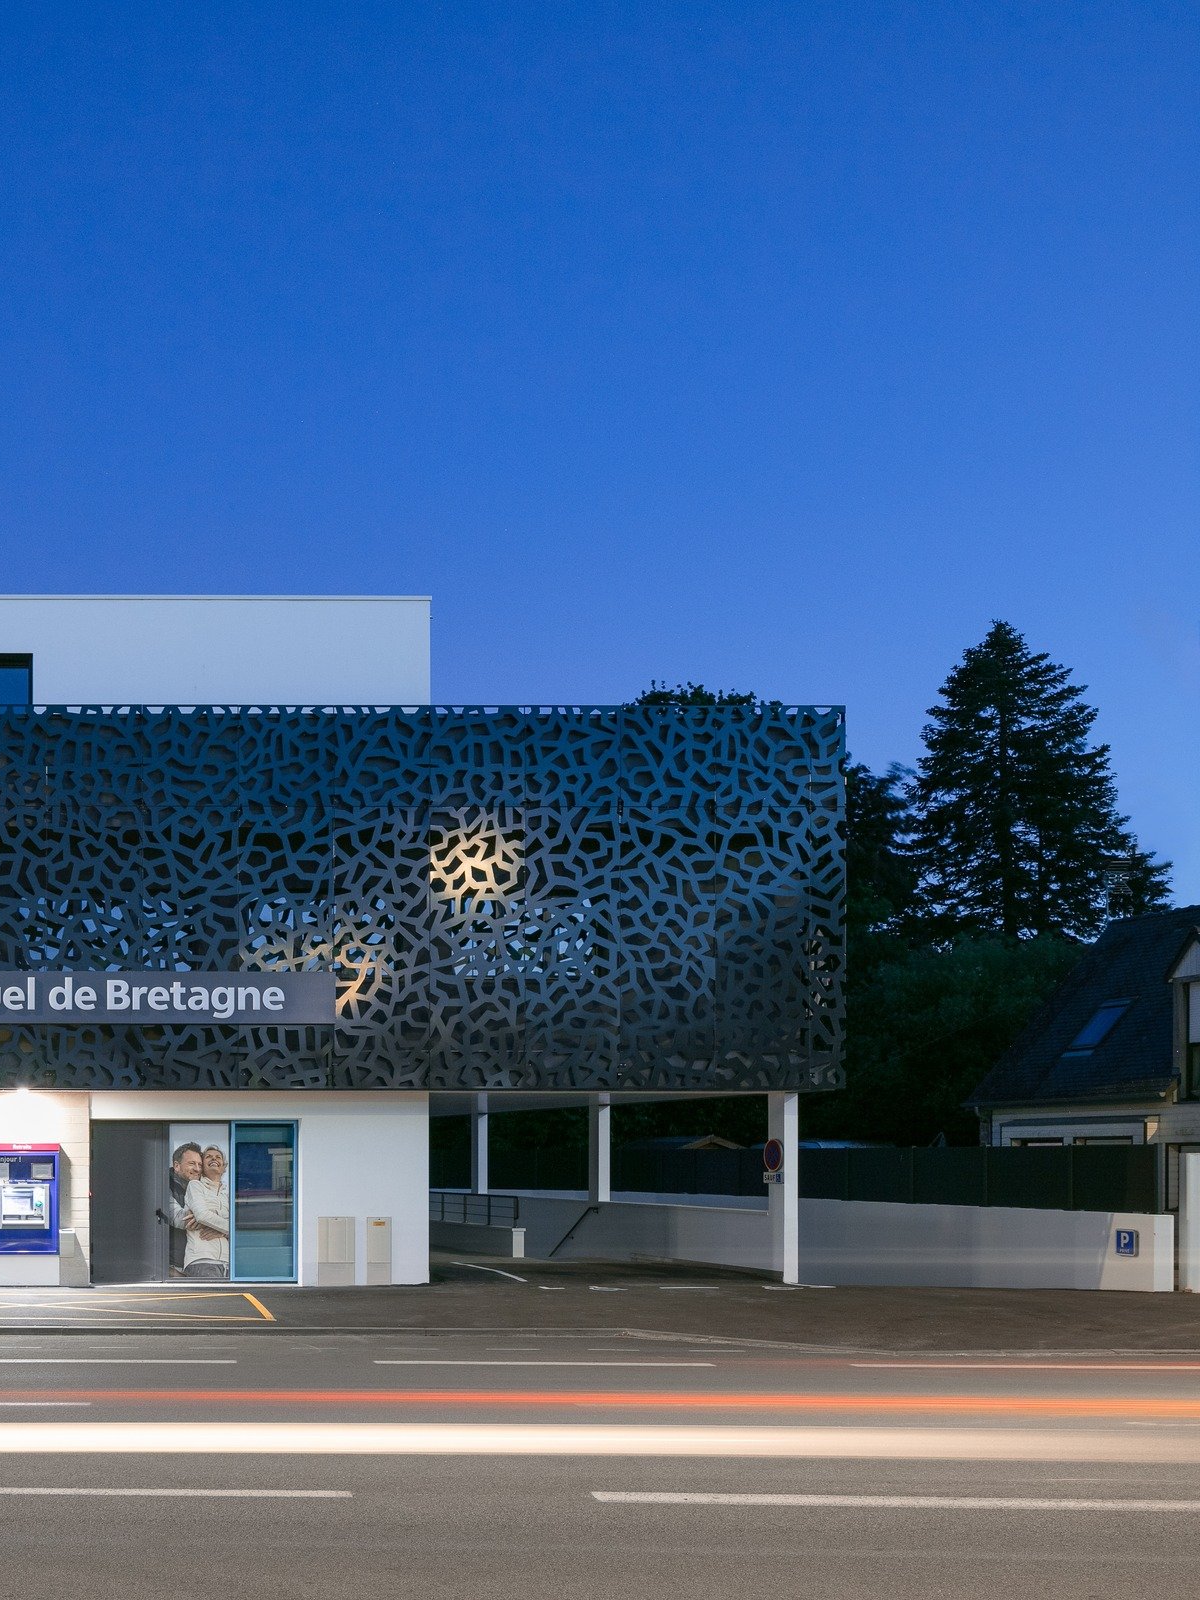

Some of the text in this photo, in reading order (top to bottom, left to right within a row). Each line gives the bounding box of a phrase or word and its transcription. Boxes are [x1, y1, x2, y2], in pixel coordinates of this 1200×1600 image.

[48, 976, 98, 1012] de
[106, 979, 286, 1020] Bretagne
[1120, 1232, 1130, 1248] P
